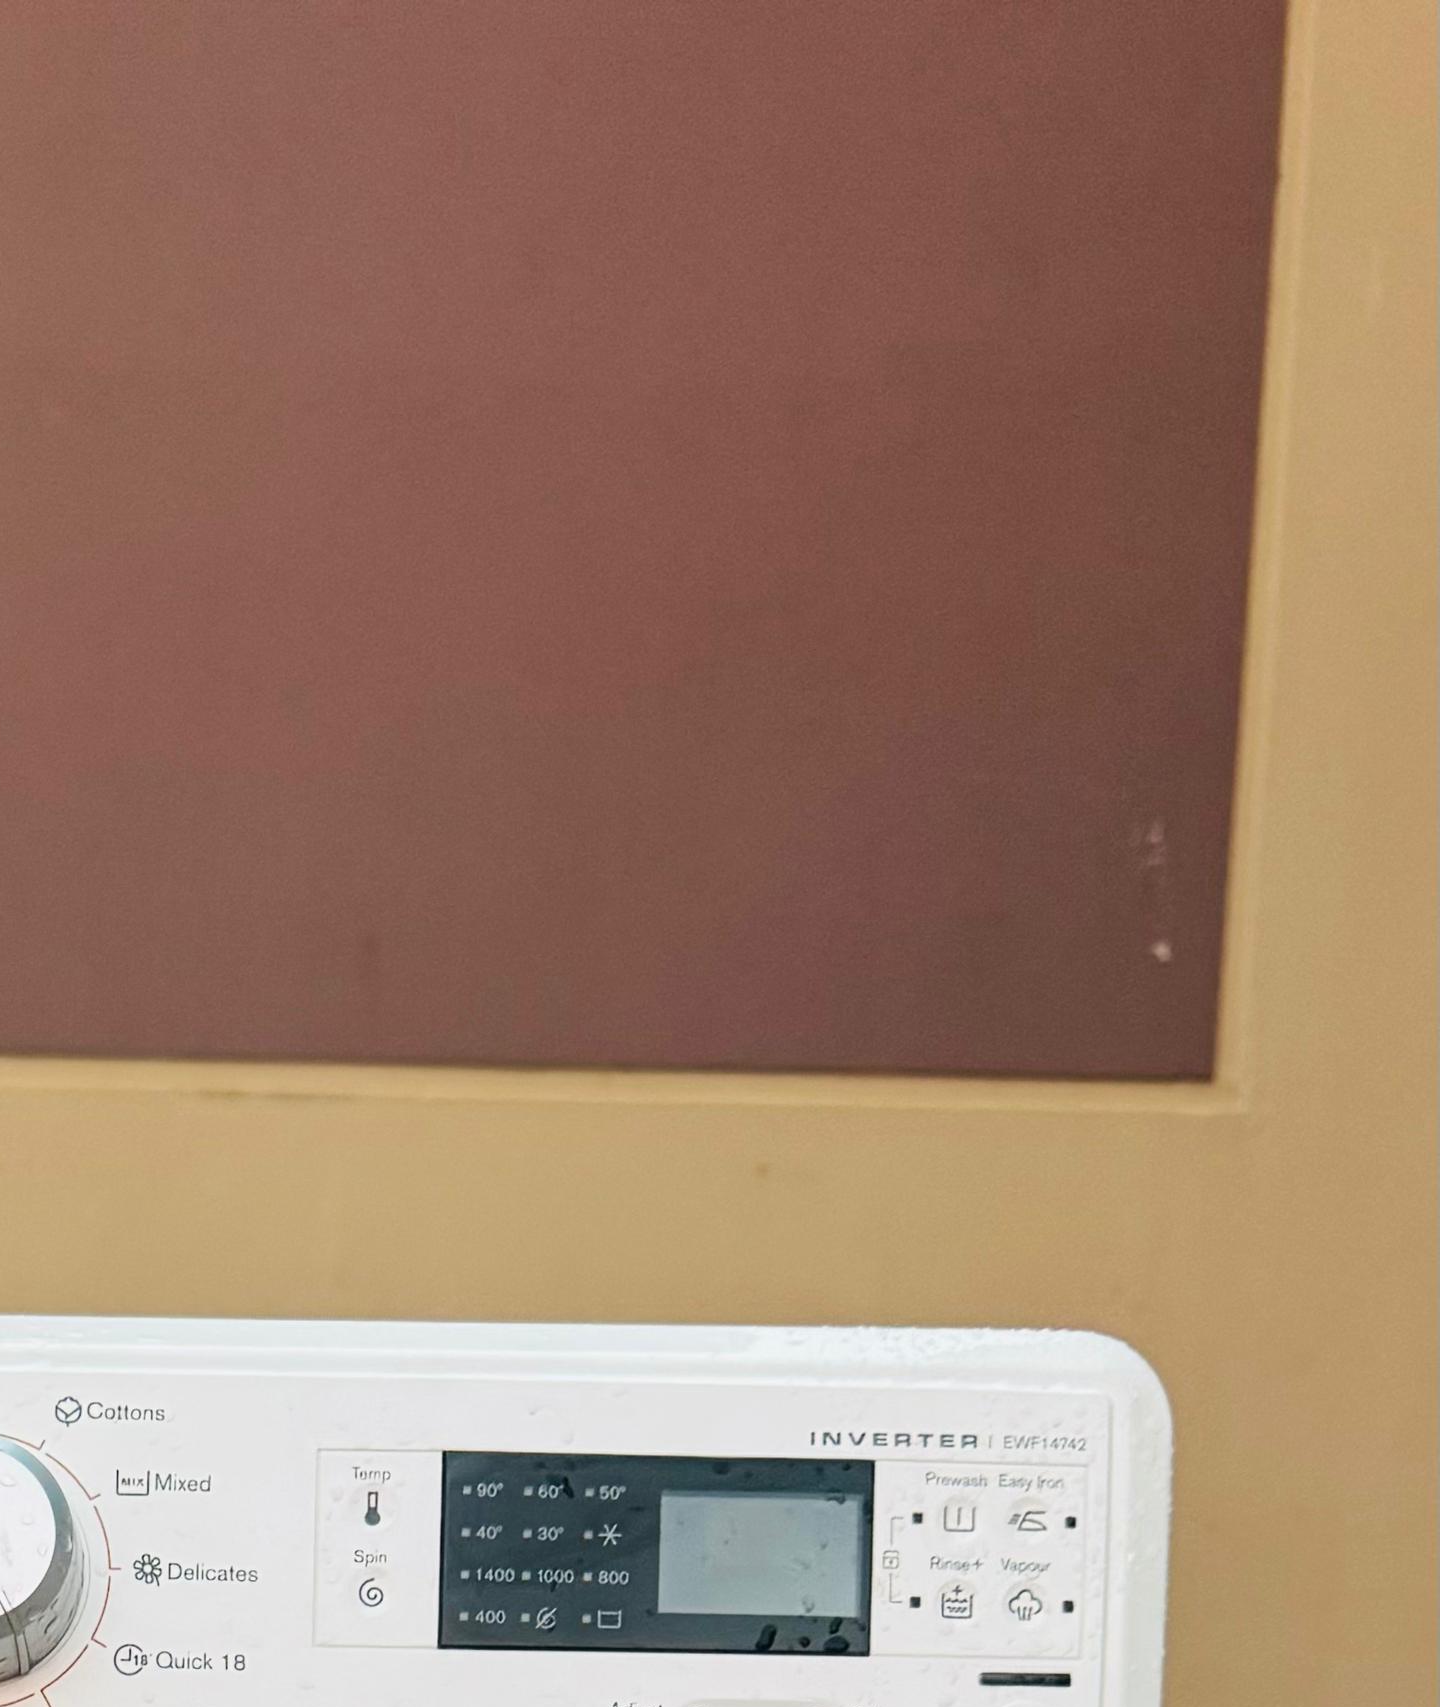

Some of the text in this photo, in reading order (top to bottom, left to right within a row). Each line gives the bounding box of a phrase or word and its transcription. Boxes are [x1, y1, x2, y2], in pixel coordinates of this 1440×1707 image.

[86, 1401, 166, 1422] Cottons
[809, 1431, 979, 1449] INVERTER
[352, 1466, 391, 1482] Temp
[925, 1471, 988, 1488] Prewash
[998, 1473, 1032, 1492] Easy
[154, 1474, 212, 1493] Mixed
[353, 1549, 388, 1566] Spin
[168, 1563, 258, 1583] Delicates
[475, 1568, 515, 1583] 1400
[597, 1570, 630, 1585] 800
[474, 1610, 506, 1625] 400
[155, 1651, 246, 1672] Quick 18
